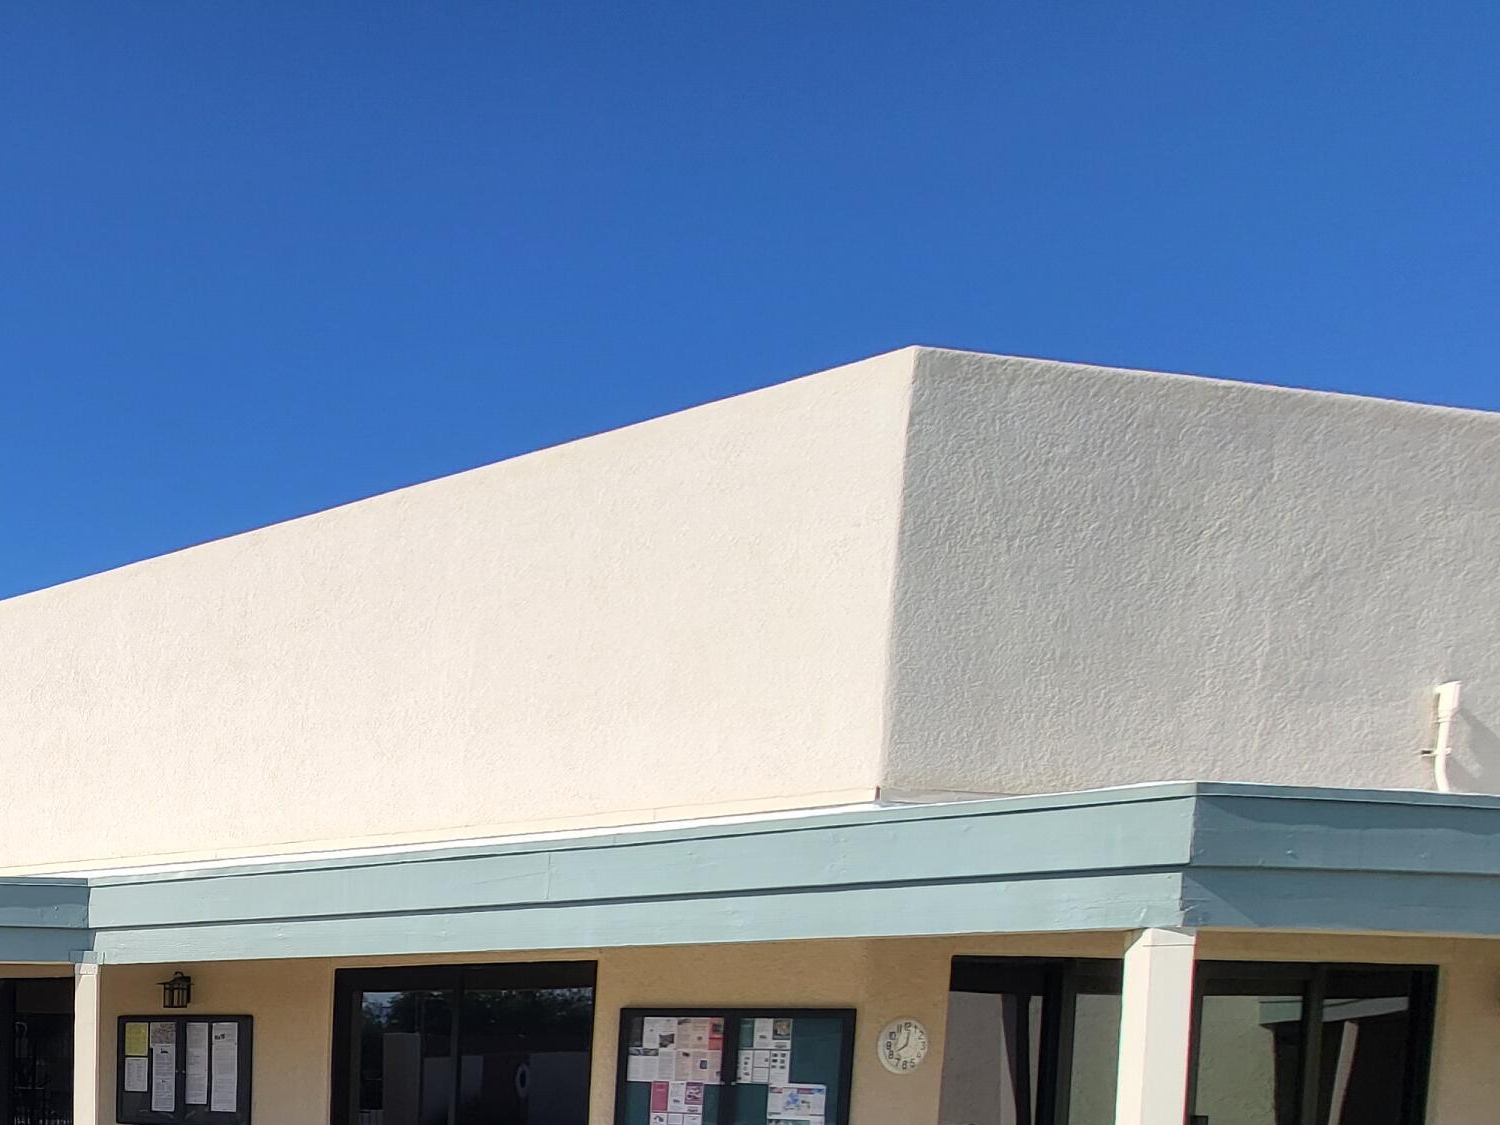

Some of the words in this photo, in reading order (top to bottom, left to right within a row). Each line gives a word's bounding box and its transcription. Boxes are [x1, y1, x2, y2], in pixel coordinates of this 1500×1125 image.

[904, 1022, 911, 1031] 12
[920, 1041, 926, 1050] 3
[894, 1057, 901, 1067] 7
[909, 1058, 916, 1068] 5
